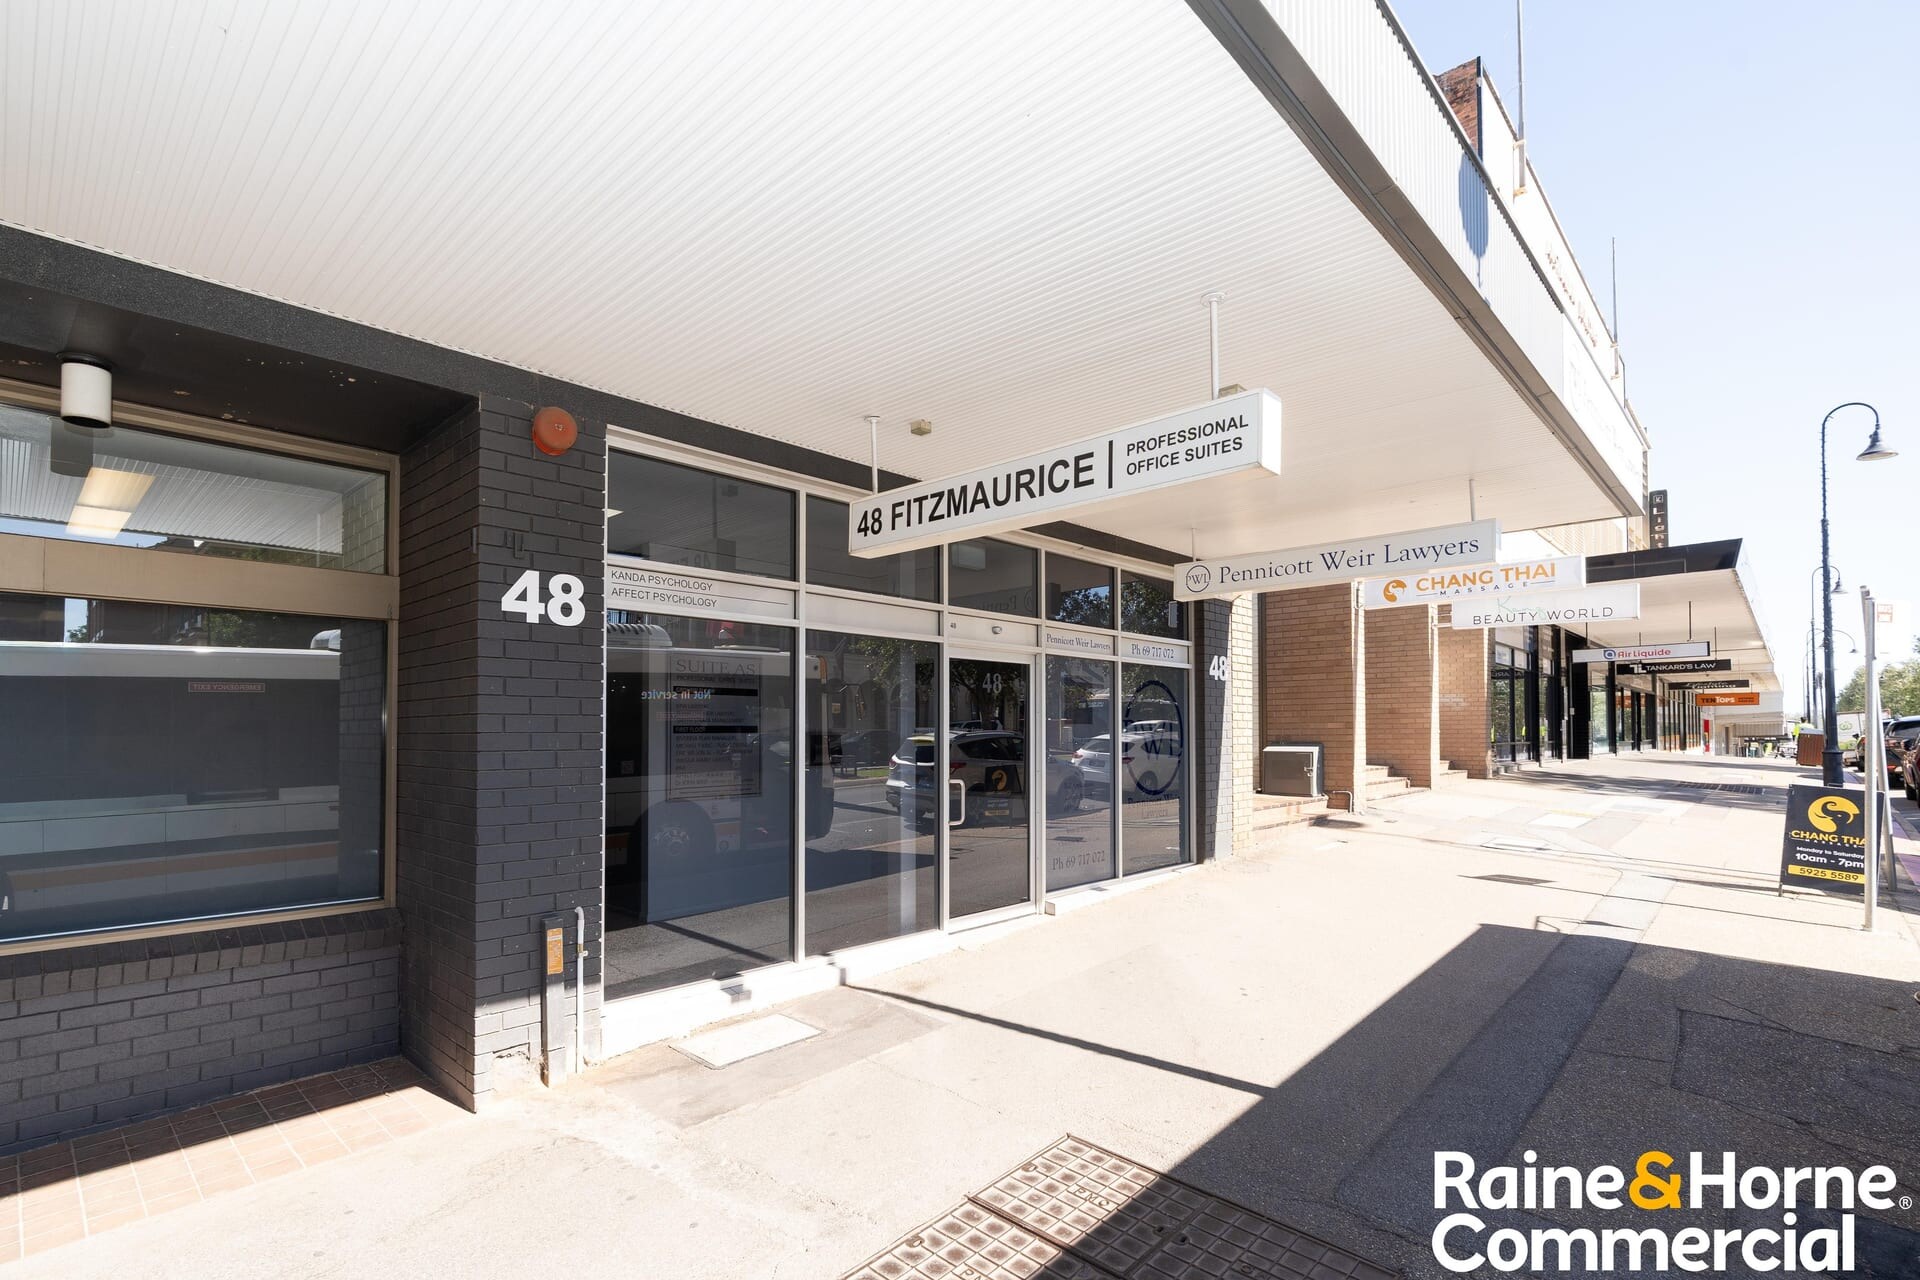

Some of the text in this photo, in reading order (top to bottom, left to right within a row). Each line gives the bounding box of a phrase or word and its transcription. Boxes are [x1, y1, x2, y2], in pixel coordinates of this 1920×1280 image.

[1126, 414, 1249, 457] PROFESSIONAL
[1126, 436, 1243, 476] OFFICE SUITES
[857, 451, 1095, 539] 48 FITZMAURICE
[1219, 537, 1480, 584] Pennicott Weir Lawyers
[611, 570, 713, 592] KANDA PSYCHOLOGY
[1415, 562, 1556, 592] CHANG THAI
[611, 587, 717, 607] AFFECT PSYCHOLOGY
[1440, 582, 1528, 596] MASSAGE
[501, 570, 585, 627] 48
[1473, 607, 1614, 625] BEAUTY WORLD
[1046, 633, 1074, 646] Pennicott
[1131, 643, 1174, 659] Ph 69 717 072
[1633, 649, 1671, 657] Liquide
[1209, 655, 1229, 681] 48
[1646, 663, 1694, 671] TANKARD'S
[982, 673, 1002, 694] 48
[1791, 830, 1866, 845] CHANG THA
[1052, 857, 1064, 871] Ph
[1065, 855, 1076, 868] 69
[1078, 853, 1091, 866] 717
[1795, 853, 1828, 863] 10am
[1838, 858, 1865, 869] 7pm
[1796, 846, 1824, 854] Monday
[1833, 851, 1865, 860] Saturday
[1799, 867, 1859, 881] 5925 5589
